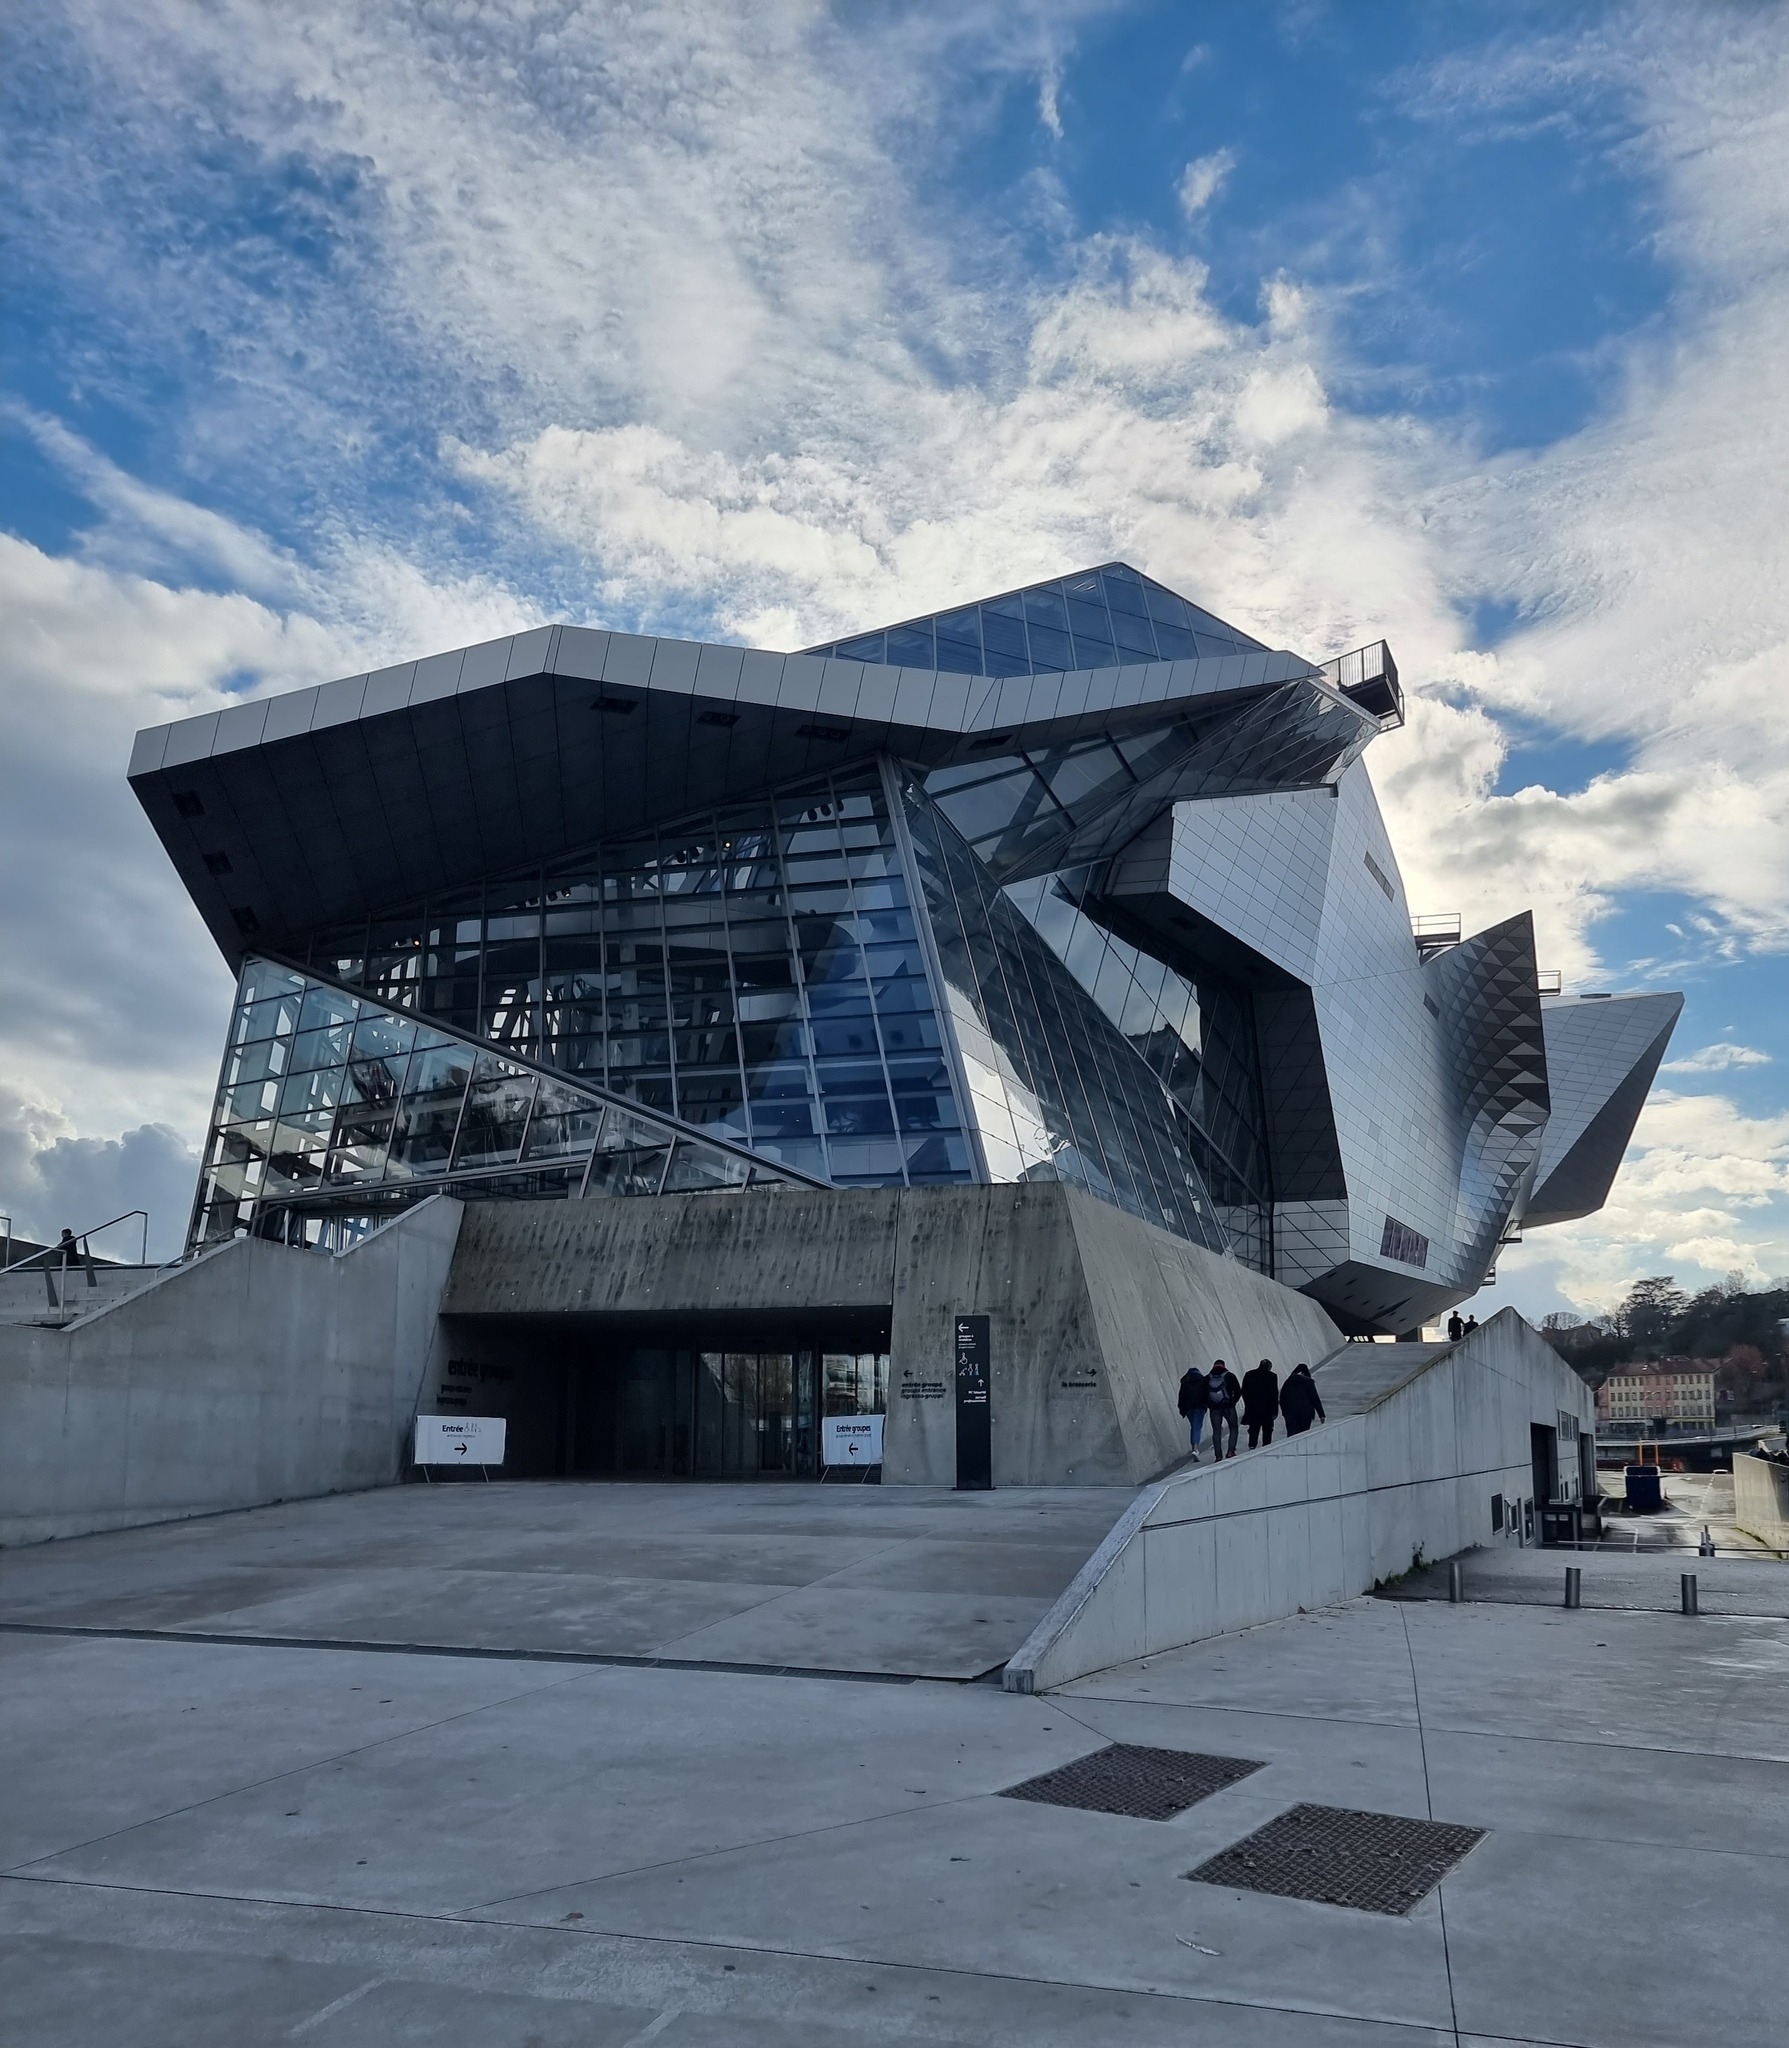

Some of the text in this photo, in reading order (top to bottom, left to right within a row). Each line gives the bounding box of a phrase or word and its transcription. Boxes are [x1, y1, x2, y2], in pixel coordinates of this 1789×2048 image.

[442, 1424, 463, 1433] Entrée
[836, 1424, 871, 1434] Entrée groupes
